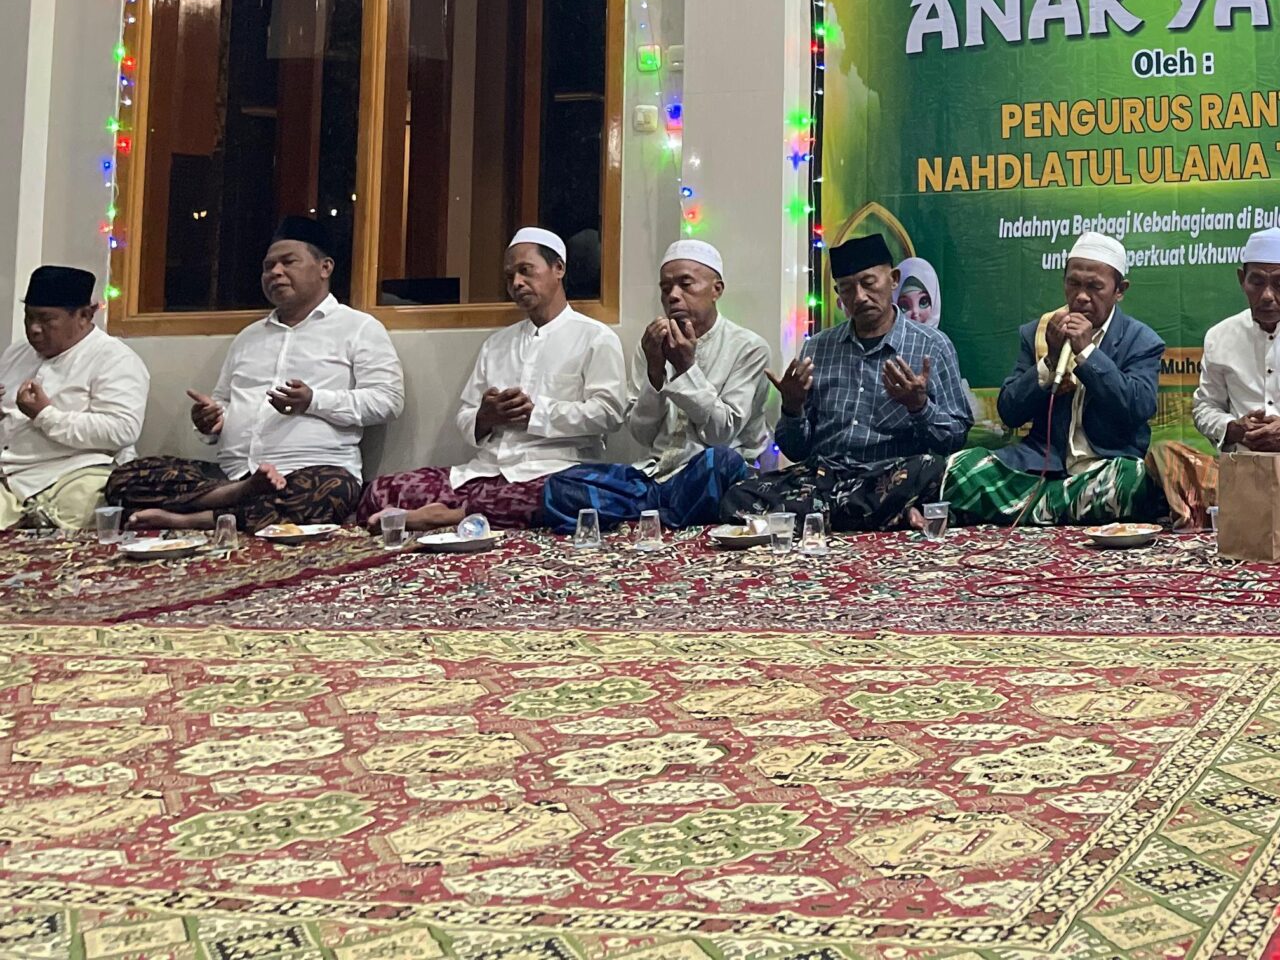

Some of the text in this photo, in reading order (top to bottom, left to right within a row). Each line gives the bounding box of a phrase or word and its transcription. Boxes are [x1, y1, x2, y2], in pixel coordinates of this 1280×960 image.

[1132, 47, 1197, 78] Oleh
[1001, 94, 1194, 139] PENGURUS
[917, 148, 1133, 193] NAHDLATUL
[1137, 142, 1271, 183] ULAMA
[999, 215, 1070, 243] Indahnya
[1072, 210, 1131, 241] Berbagi
[1132, 207, 1234, 239] Kebahagiaan
[1236, 205, 1252, 229] di
